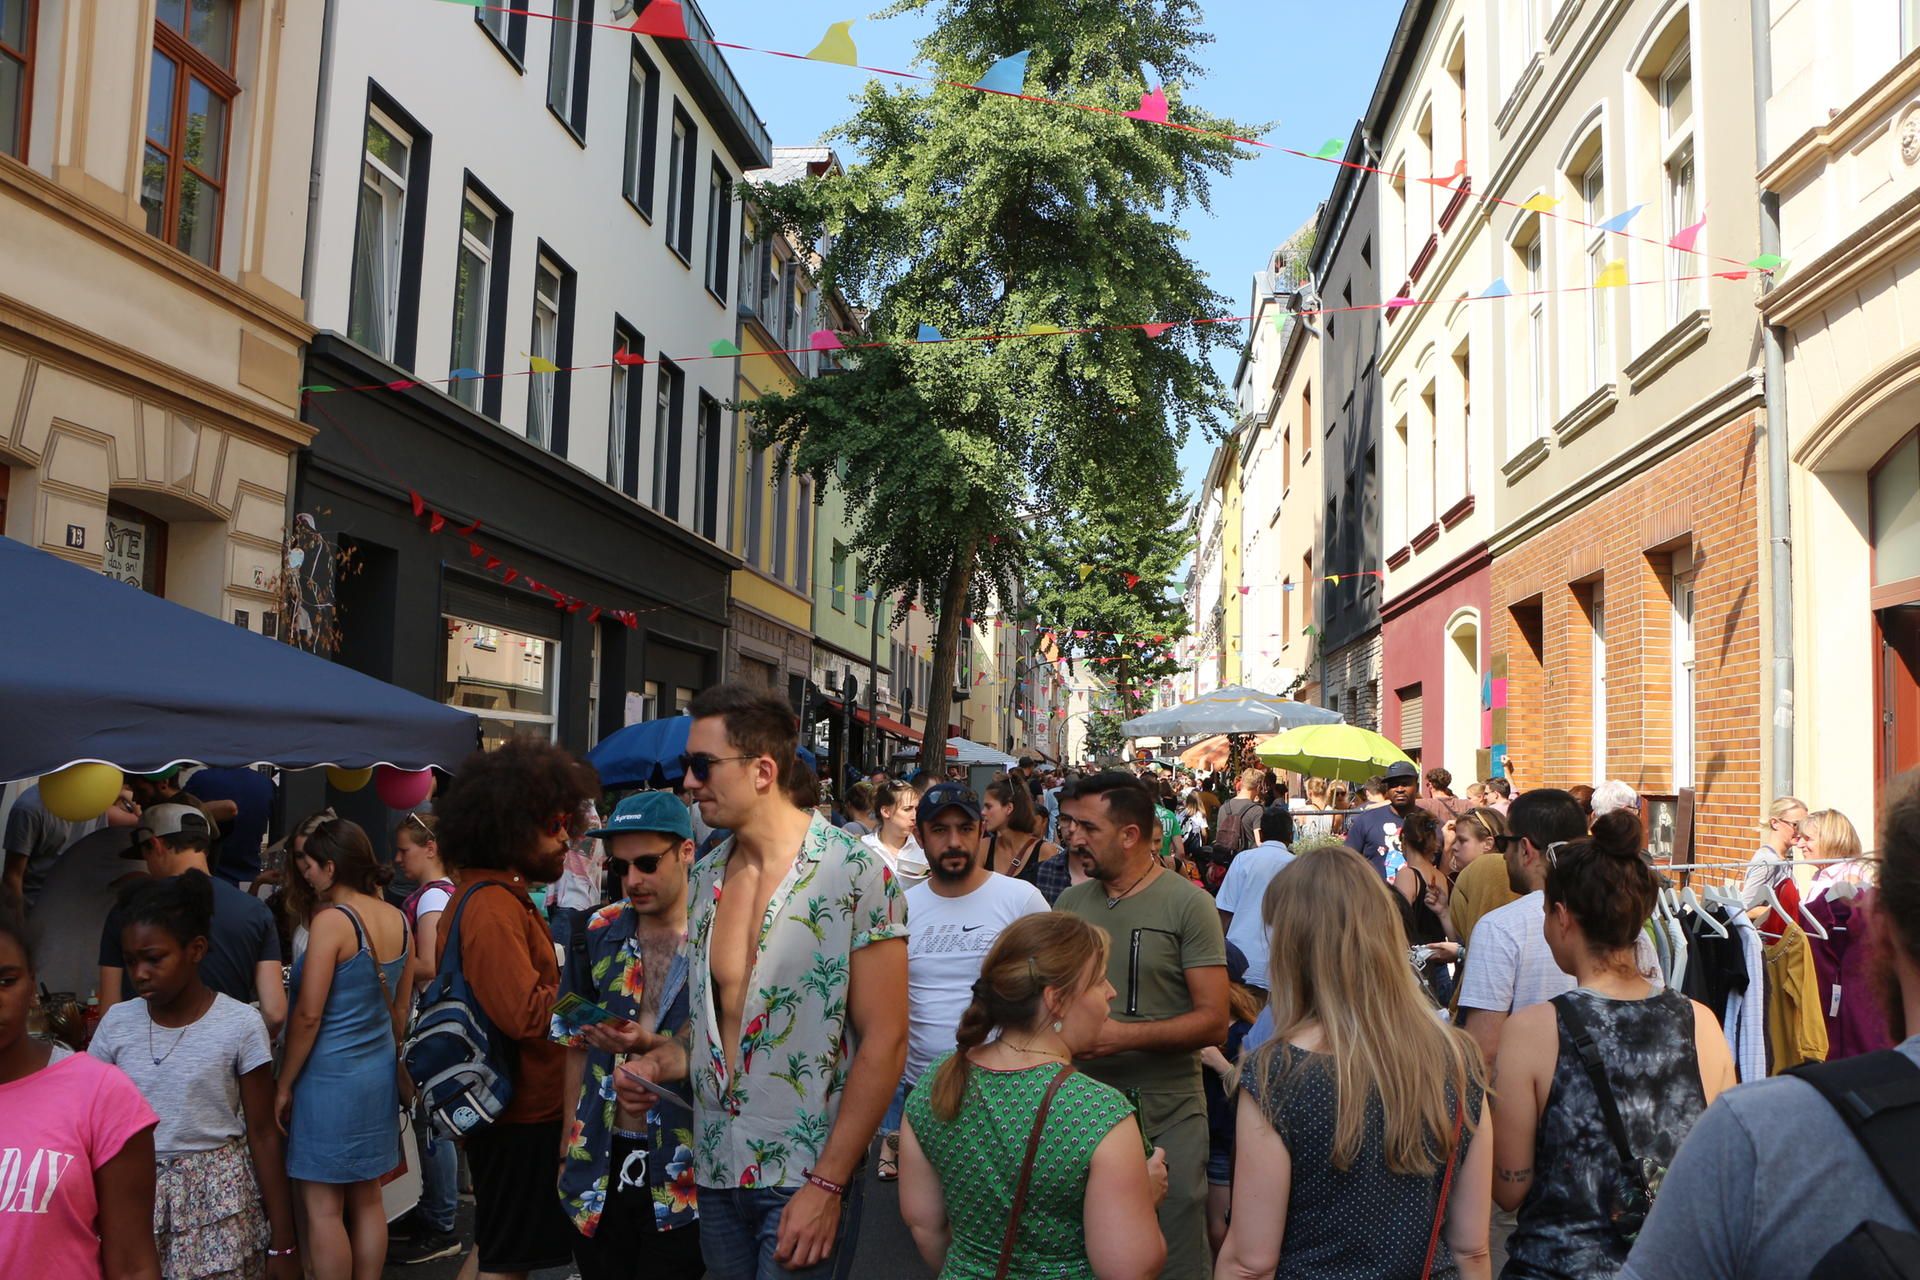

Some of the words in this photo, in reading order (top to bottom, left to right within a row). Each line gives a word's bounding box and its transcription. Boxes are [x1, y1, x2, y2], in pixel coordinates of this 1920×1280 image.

[71, 527, 83, 546] 13
[105, 521, 141, 560] STE
[0, 1147, 75, 1214] DAY
